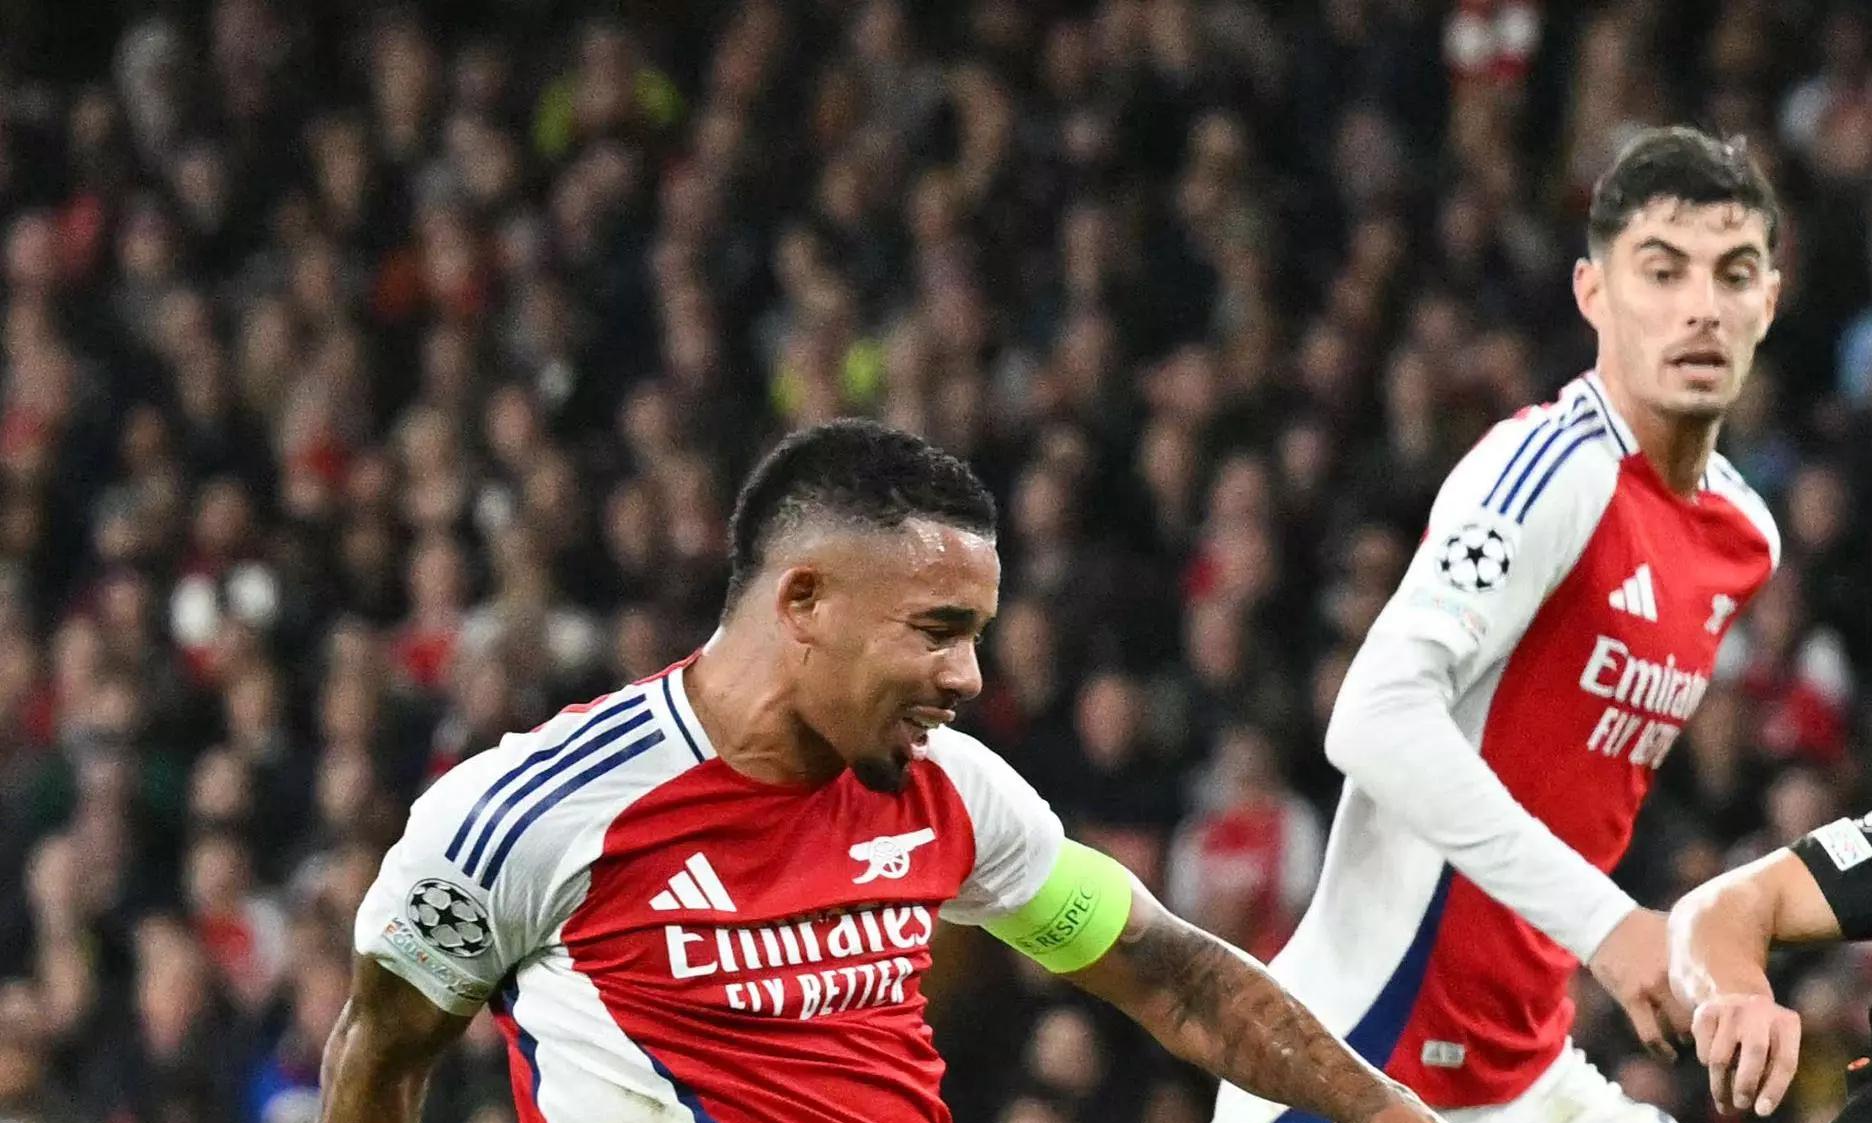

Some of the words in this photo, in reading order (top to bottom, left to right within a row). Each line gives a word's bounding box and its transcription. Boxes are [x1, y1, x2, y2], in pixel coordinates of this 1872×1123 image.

[664, 904, 932, 979] Emirates
[1035, 884, 1095, 948] RESPEC
[796, 956, 914, 1021] BETTER
